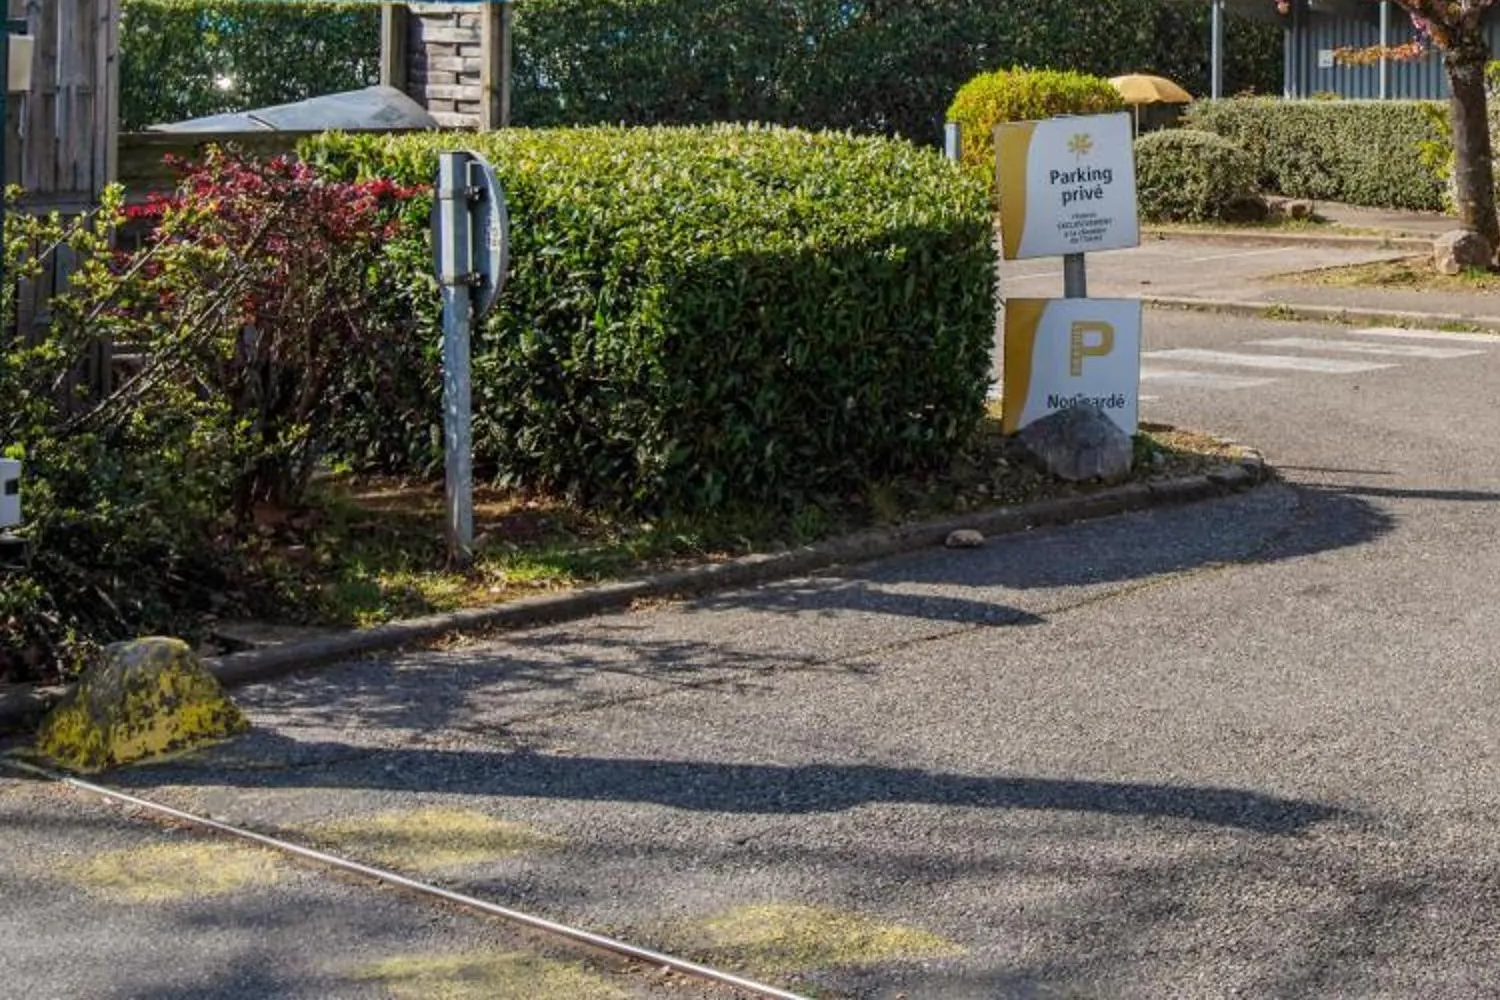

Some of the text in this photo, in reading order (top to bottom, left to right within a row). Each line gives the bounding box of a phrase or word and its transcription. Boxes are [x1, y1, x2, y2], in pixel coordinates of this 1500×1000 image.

[1050, 166, 1113, 186] Parking
[1062, 184, 1104, 206] privé
[1070, 320, 1115, 377] P
